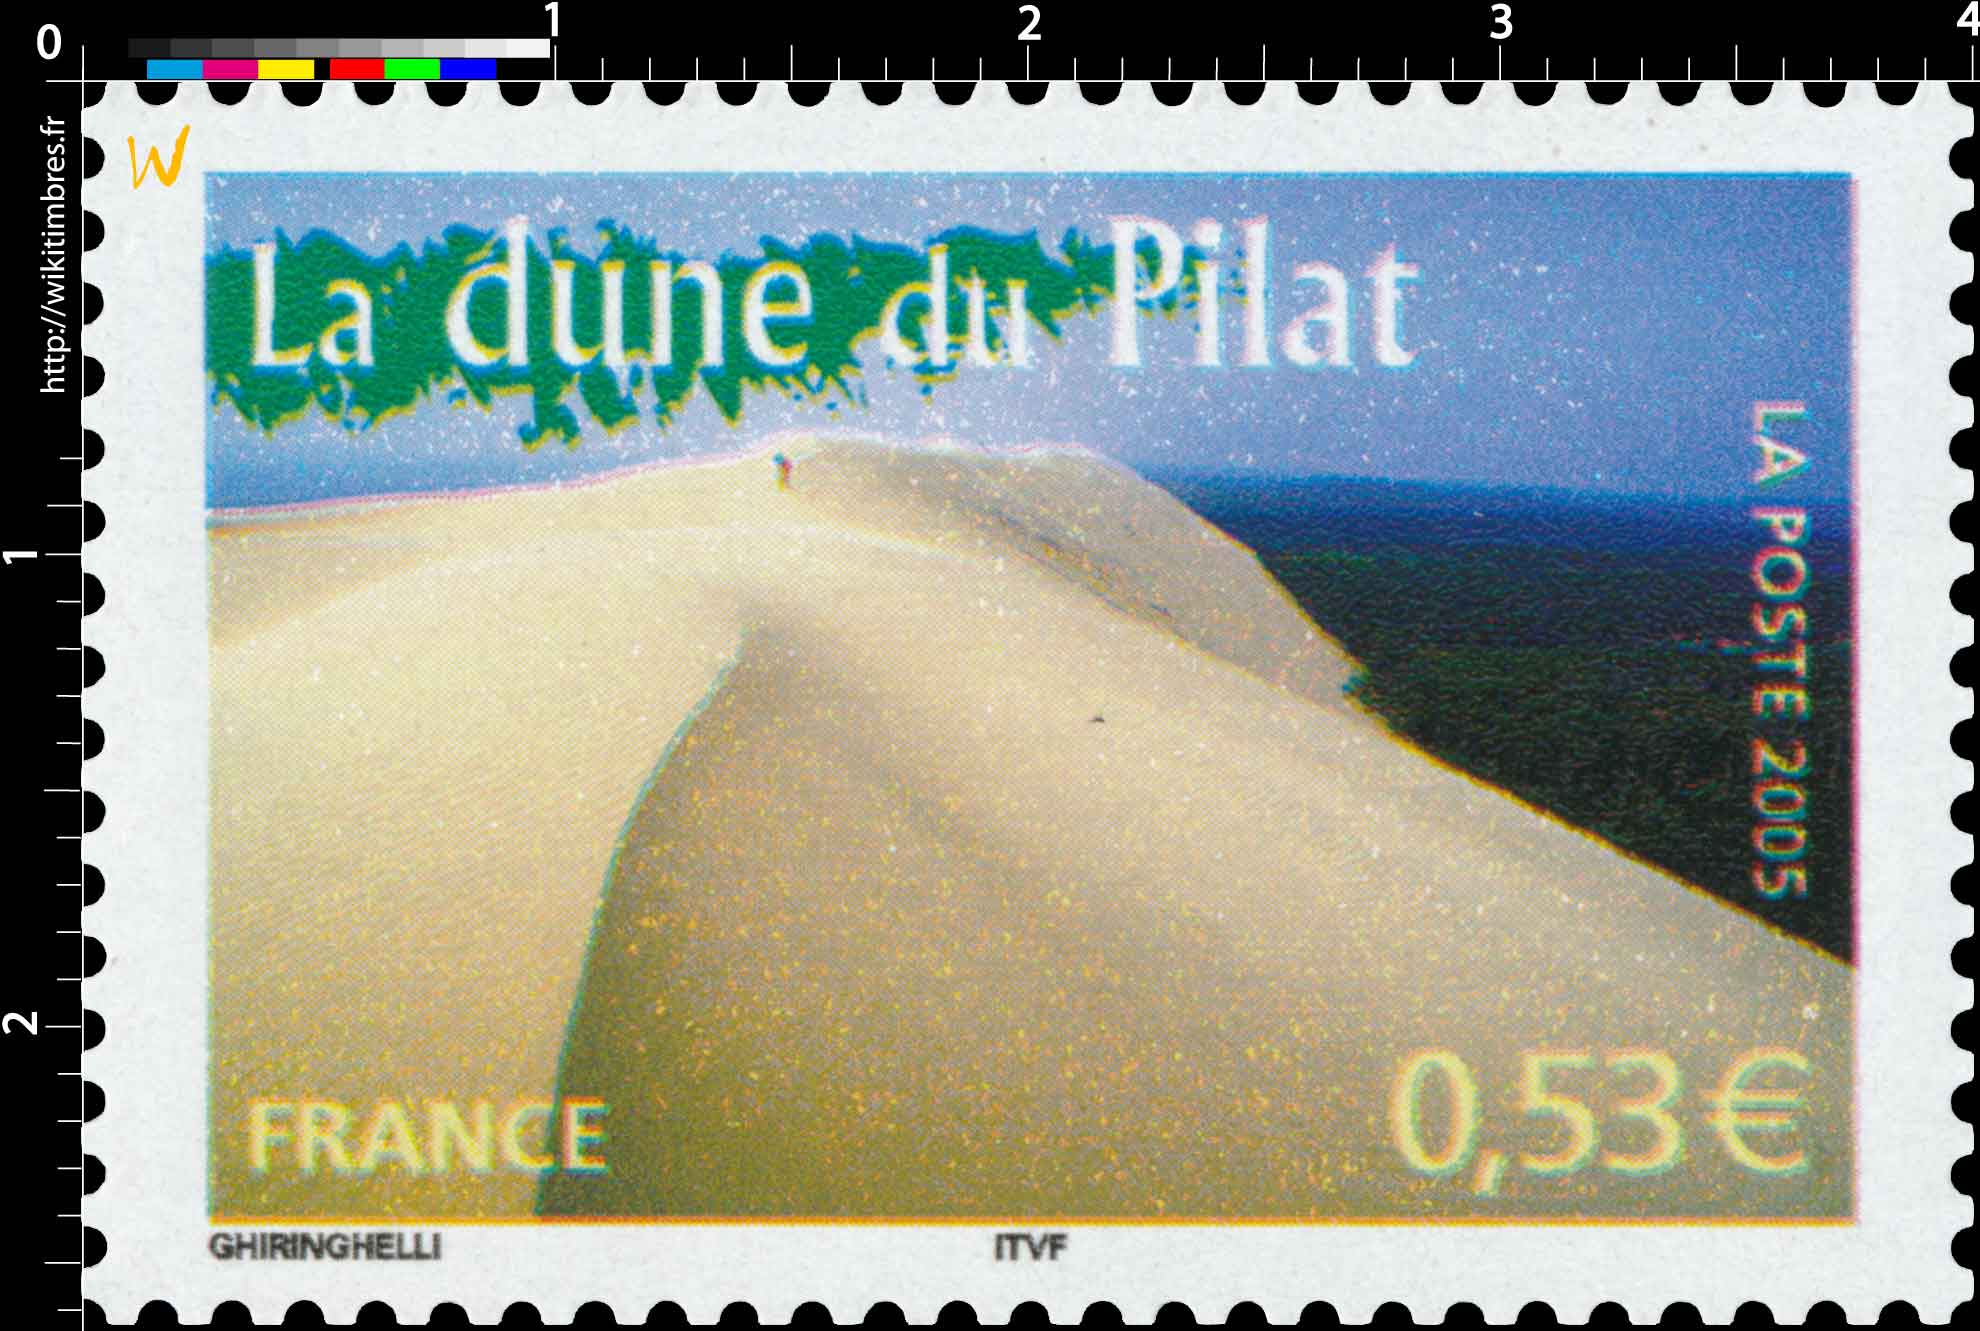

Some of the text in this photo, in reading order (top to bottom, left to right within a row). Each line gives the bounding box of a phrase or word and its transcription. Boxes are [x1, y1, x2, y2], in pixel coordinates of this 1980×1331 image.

[251, 214, 1422, 371] La dune du Pilat
[1752, 402, 1812, 900] LA POSTE 2005
[248, 1097, 610, 1175] FRANCE
[209, 1233, 441, 1261] GHIRINGHELLI
[995, 1233, 1068, 1261] ITVF
